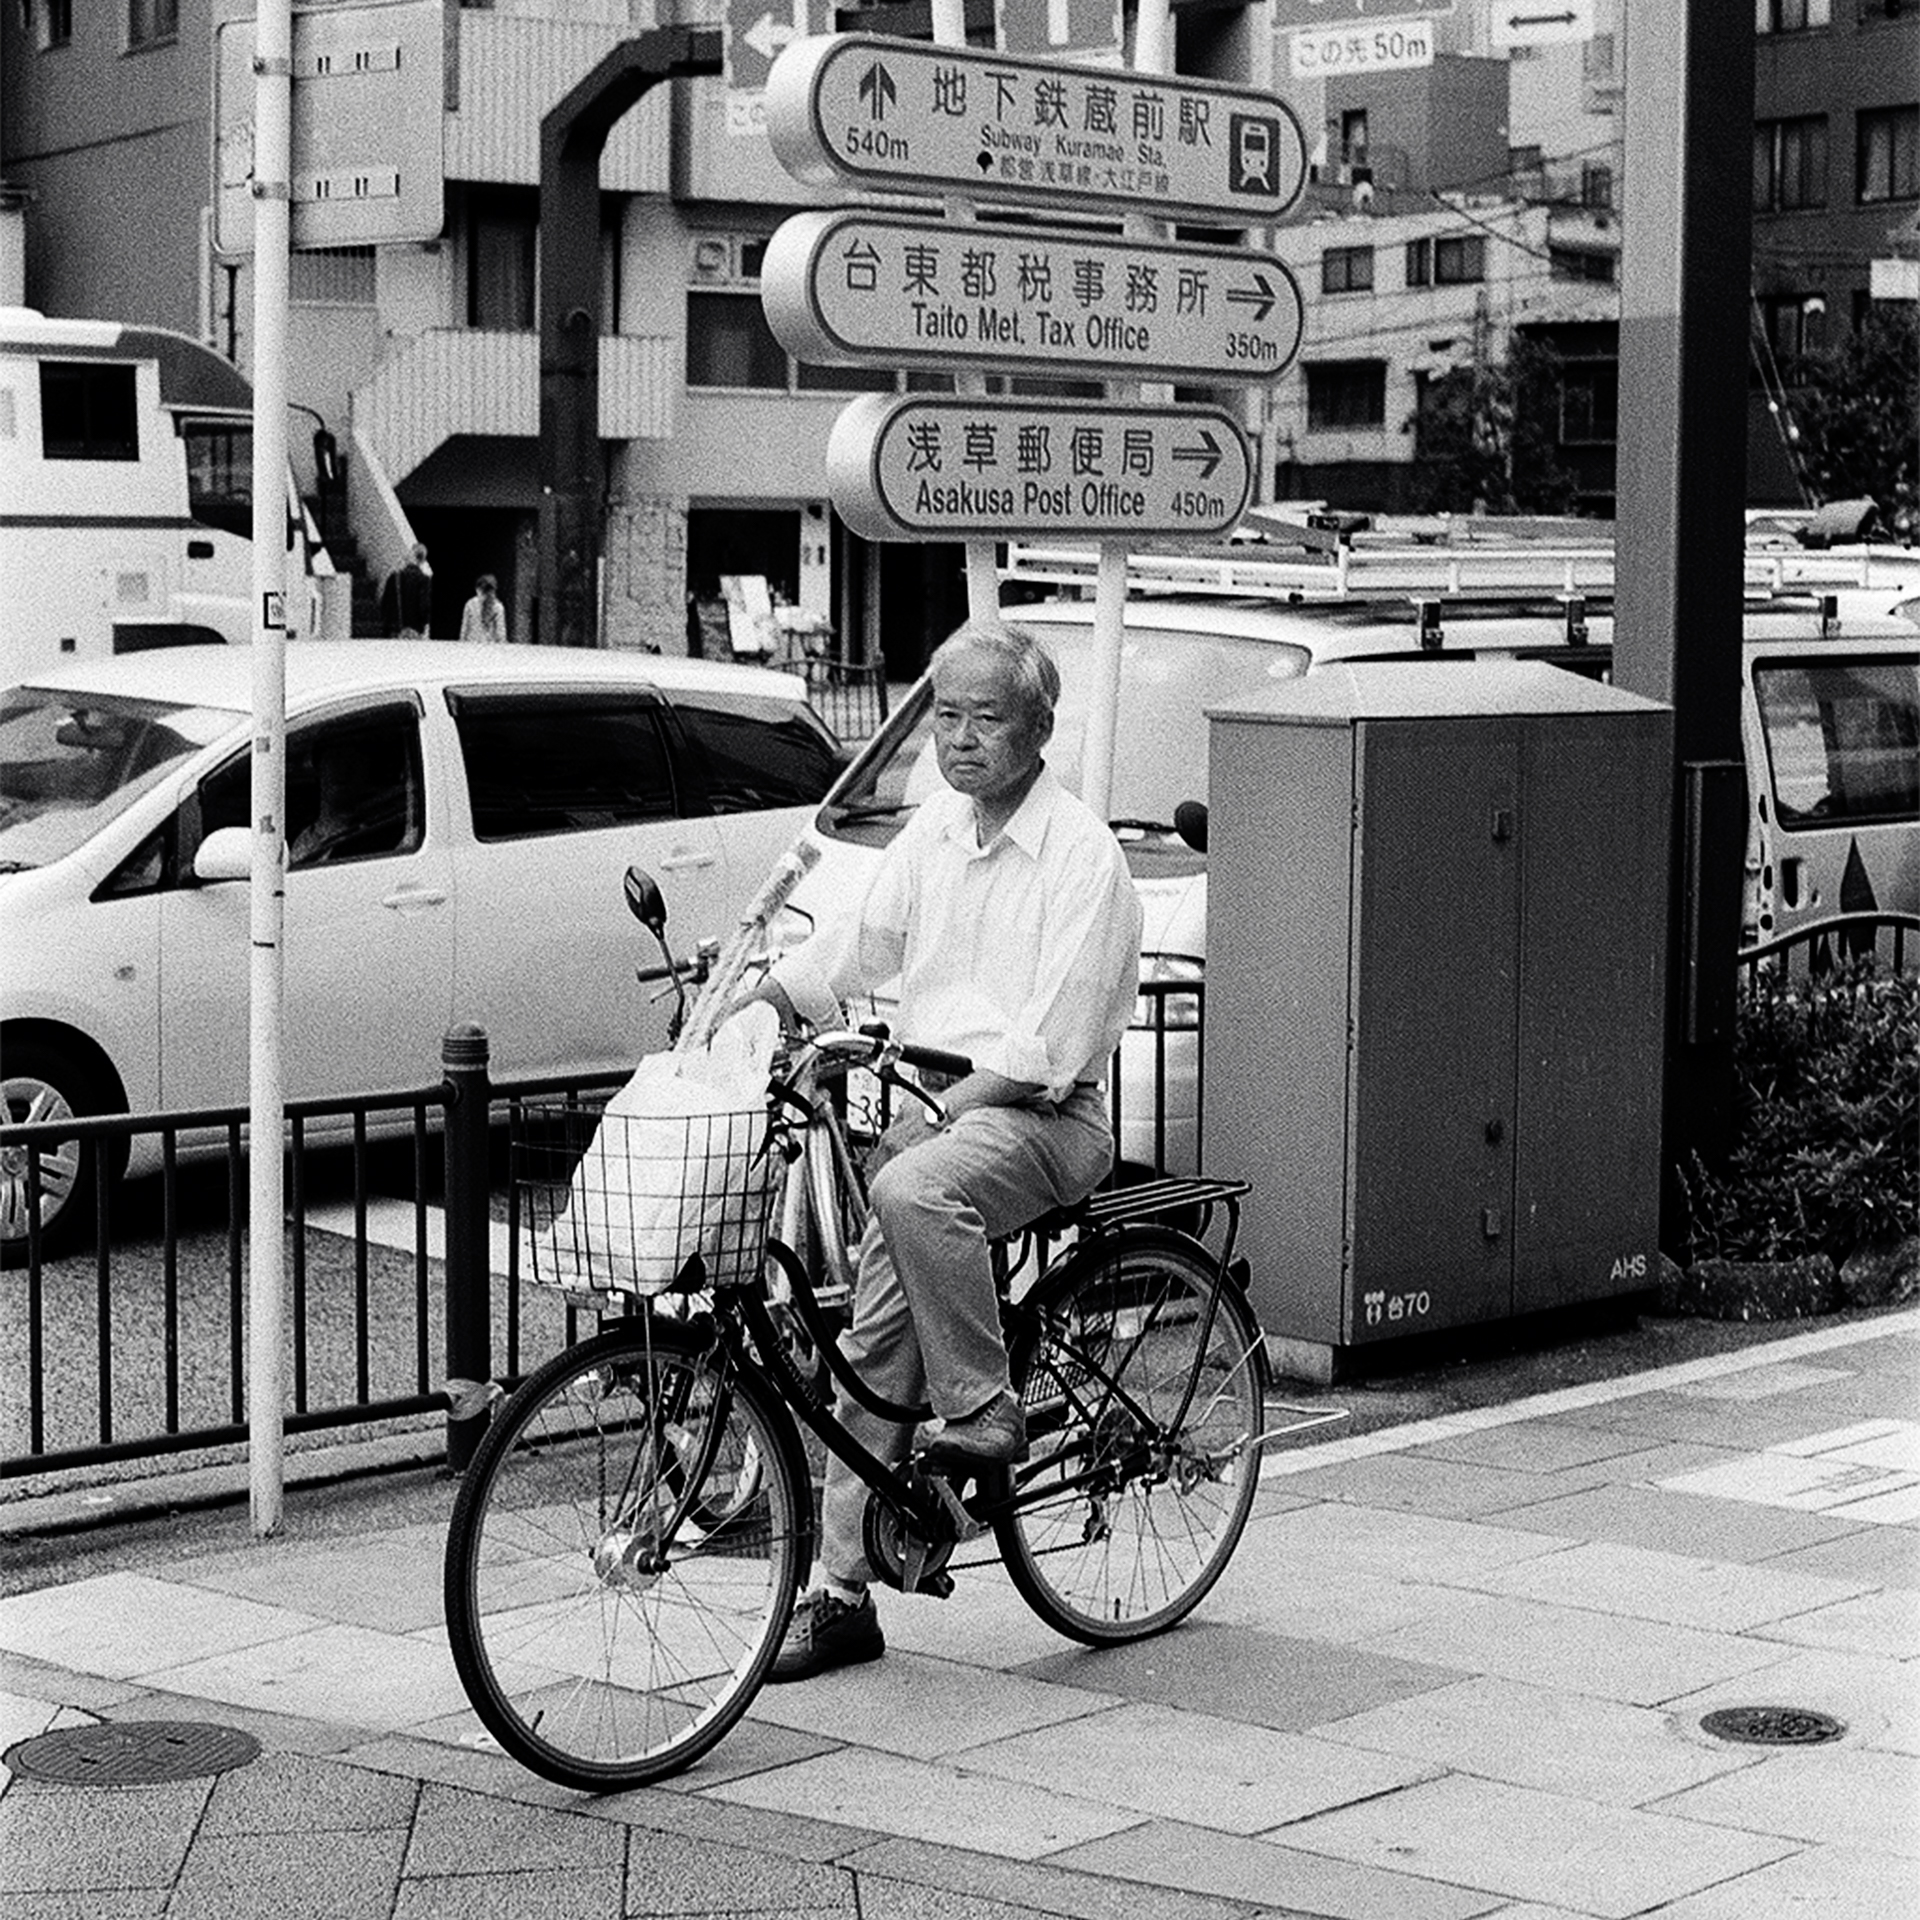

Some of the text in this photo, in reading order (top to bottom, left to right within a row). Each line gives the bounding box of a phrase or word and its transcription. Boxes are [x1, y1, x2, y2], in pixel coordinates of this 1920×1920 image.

[932, 65, 1211, 147] 地下鉄蔵前駅
[846, 127, 909, 162] 540m
[981, 124, 1168, 169] Subway Kuramae Sta.
[843, 238, 1208, 318] 台東都税事務所
[912, 303, 1150, 352] Taito Met. Tax Office
[1225, 333, 1278, 362] 350m
[906, 421, 1154, 477] 浅草郵便局
[916, 480, 1145, 517] Asakusa Post Office
[1170, 491, 1224, 518] 450m
[1610, 1254, 1646, 1281] AHS
